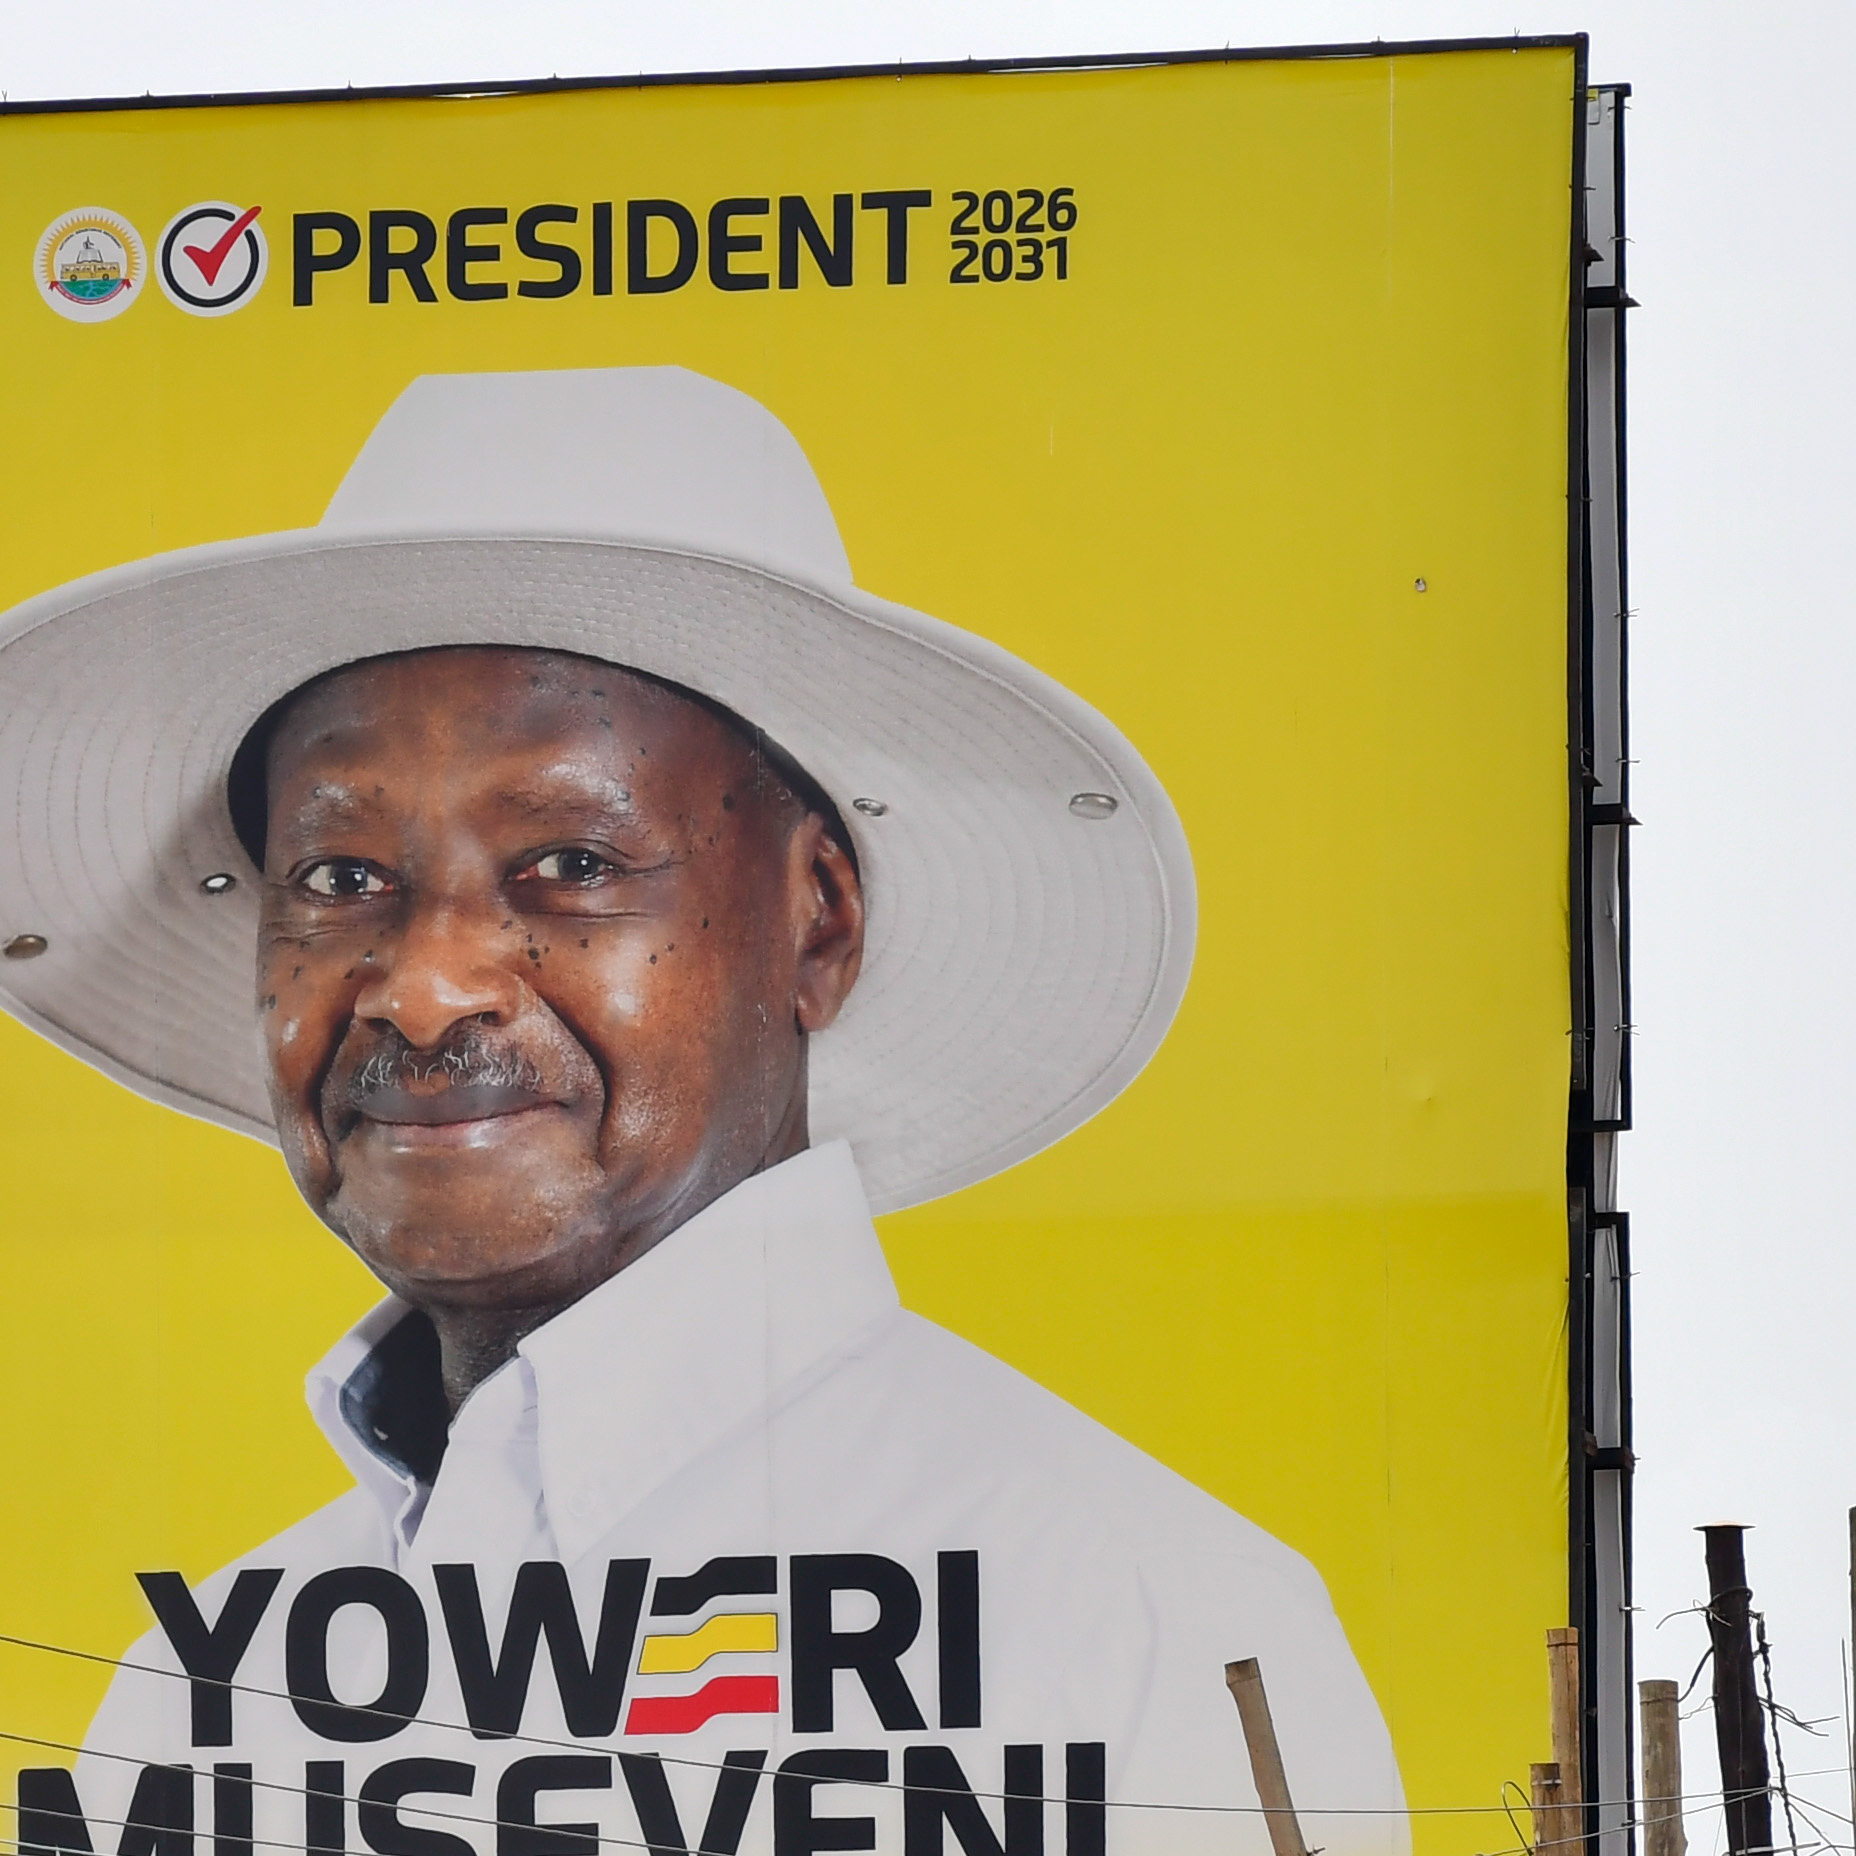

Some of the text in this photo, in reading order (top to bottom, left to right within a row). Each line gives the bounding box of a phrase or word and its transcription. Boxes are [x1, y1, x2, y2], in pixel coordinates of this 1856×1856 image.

[292, 189, 932, 307] PRESIDENT
[949, 187, 1079, 236] 2026
[949, 236, 1070, 285] 2031
[135, 1550, 982, 1748] YOWERI
